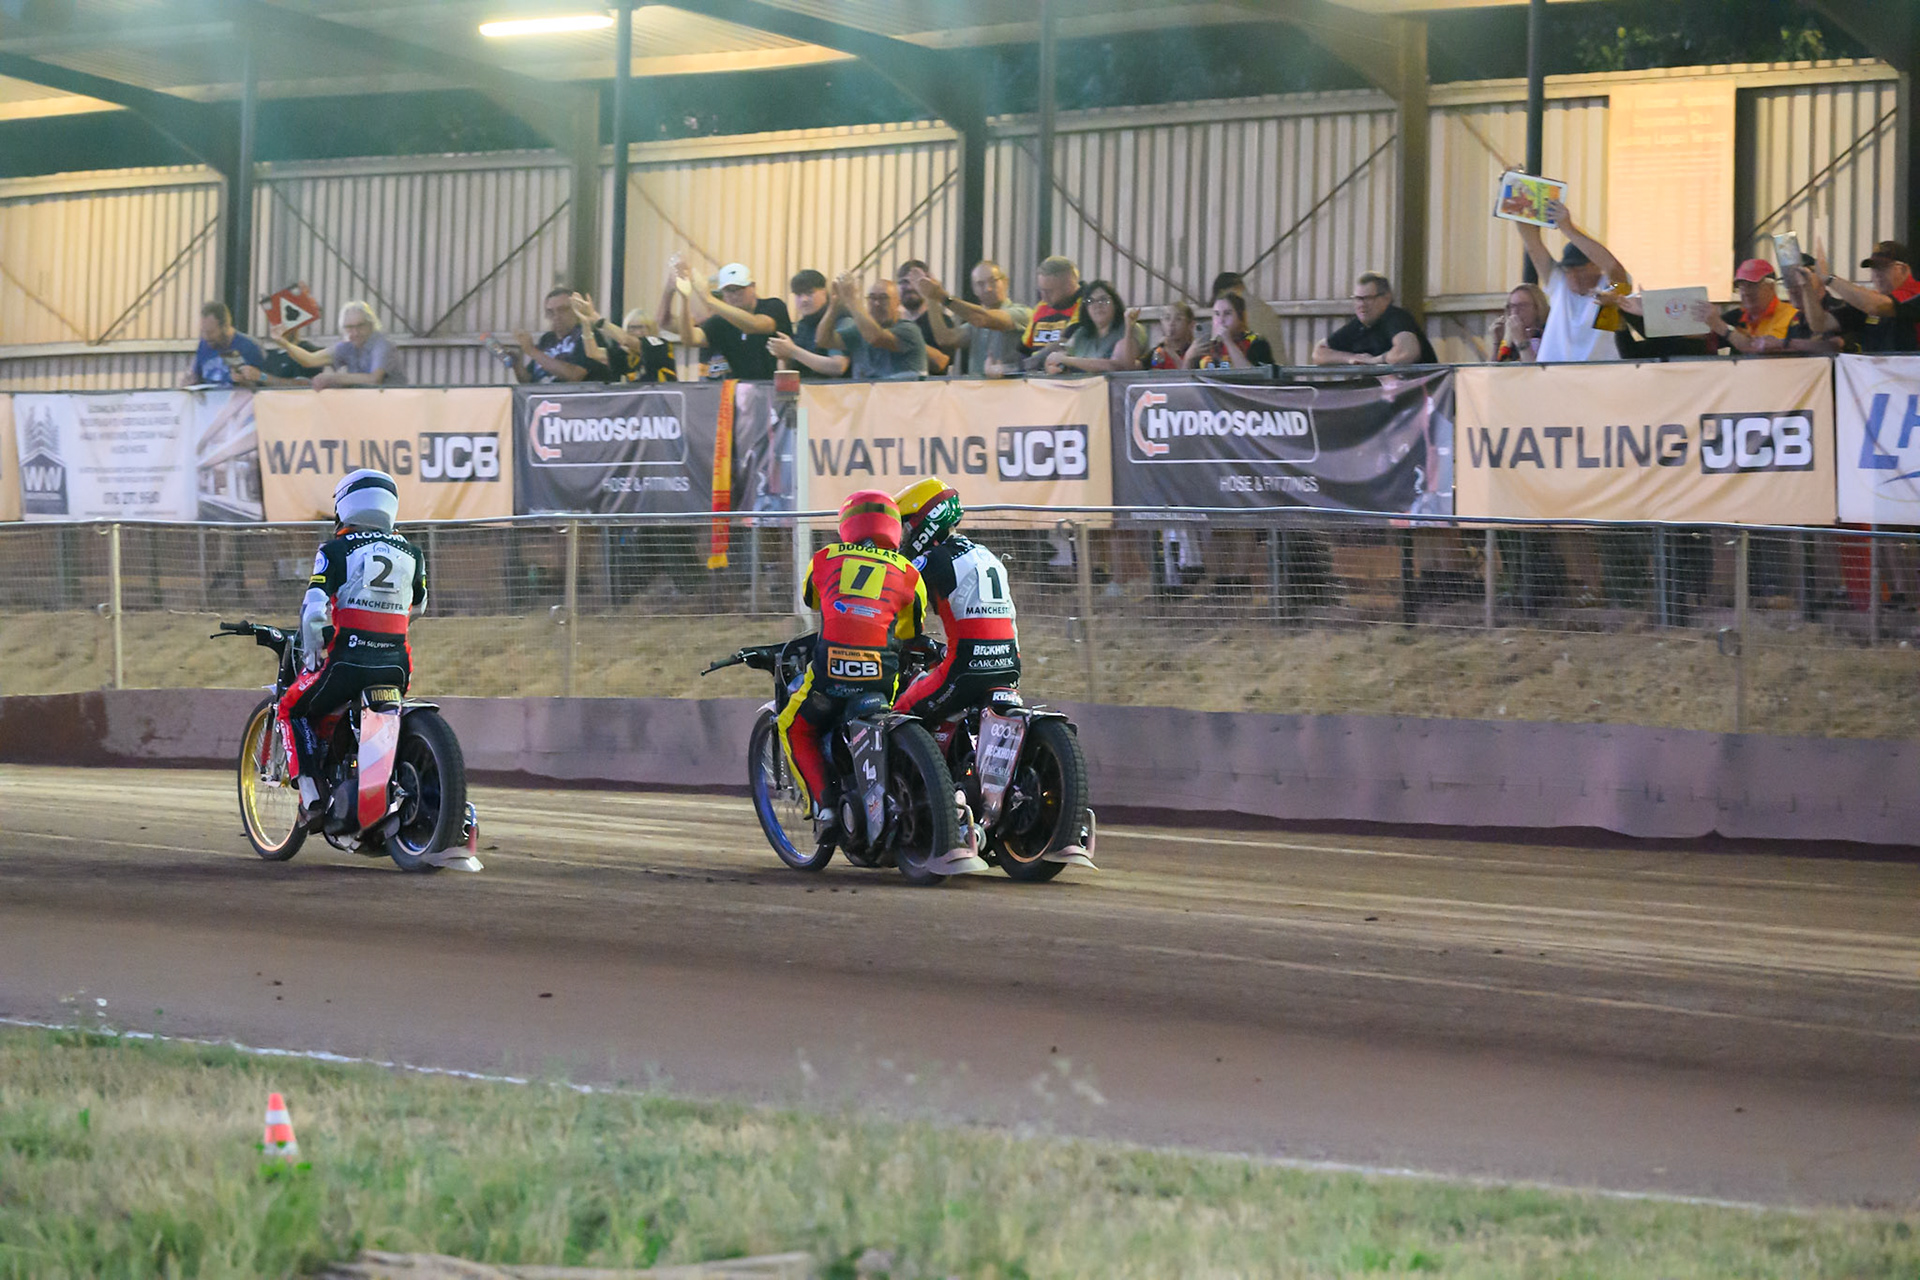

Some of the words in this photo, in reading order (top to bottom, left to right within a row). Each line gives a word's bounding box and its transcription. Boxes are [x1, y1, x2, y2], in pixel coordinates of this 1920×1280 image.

[543, 416, 681, 444] HYDROSCAND
[1147, 408, 1309, 439] HYDROSCAND
[265, 439, 412, 475] WATLING
[421, 436, 499, 479] JCB
[809, 436, 988, 477] WATLING
[999, 429, 1087, 477] JCB
[1467, 423, 1688, 469] WATLING
[1702, 416, 1812, 469] JCB
[370, 555, 394, 588] 2
[851, 564, 876, 590] 1
[986, 566, 1003, 599] 1
[831, 659, 879, 677] JCB
